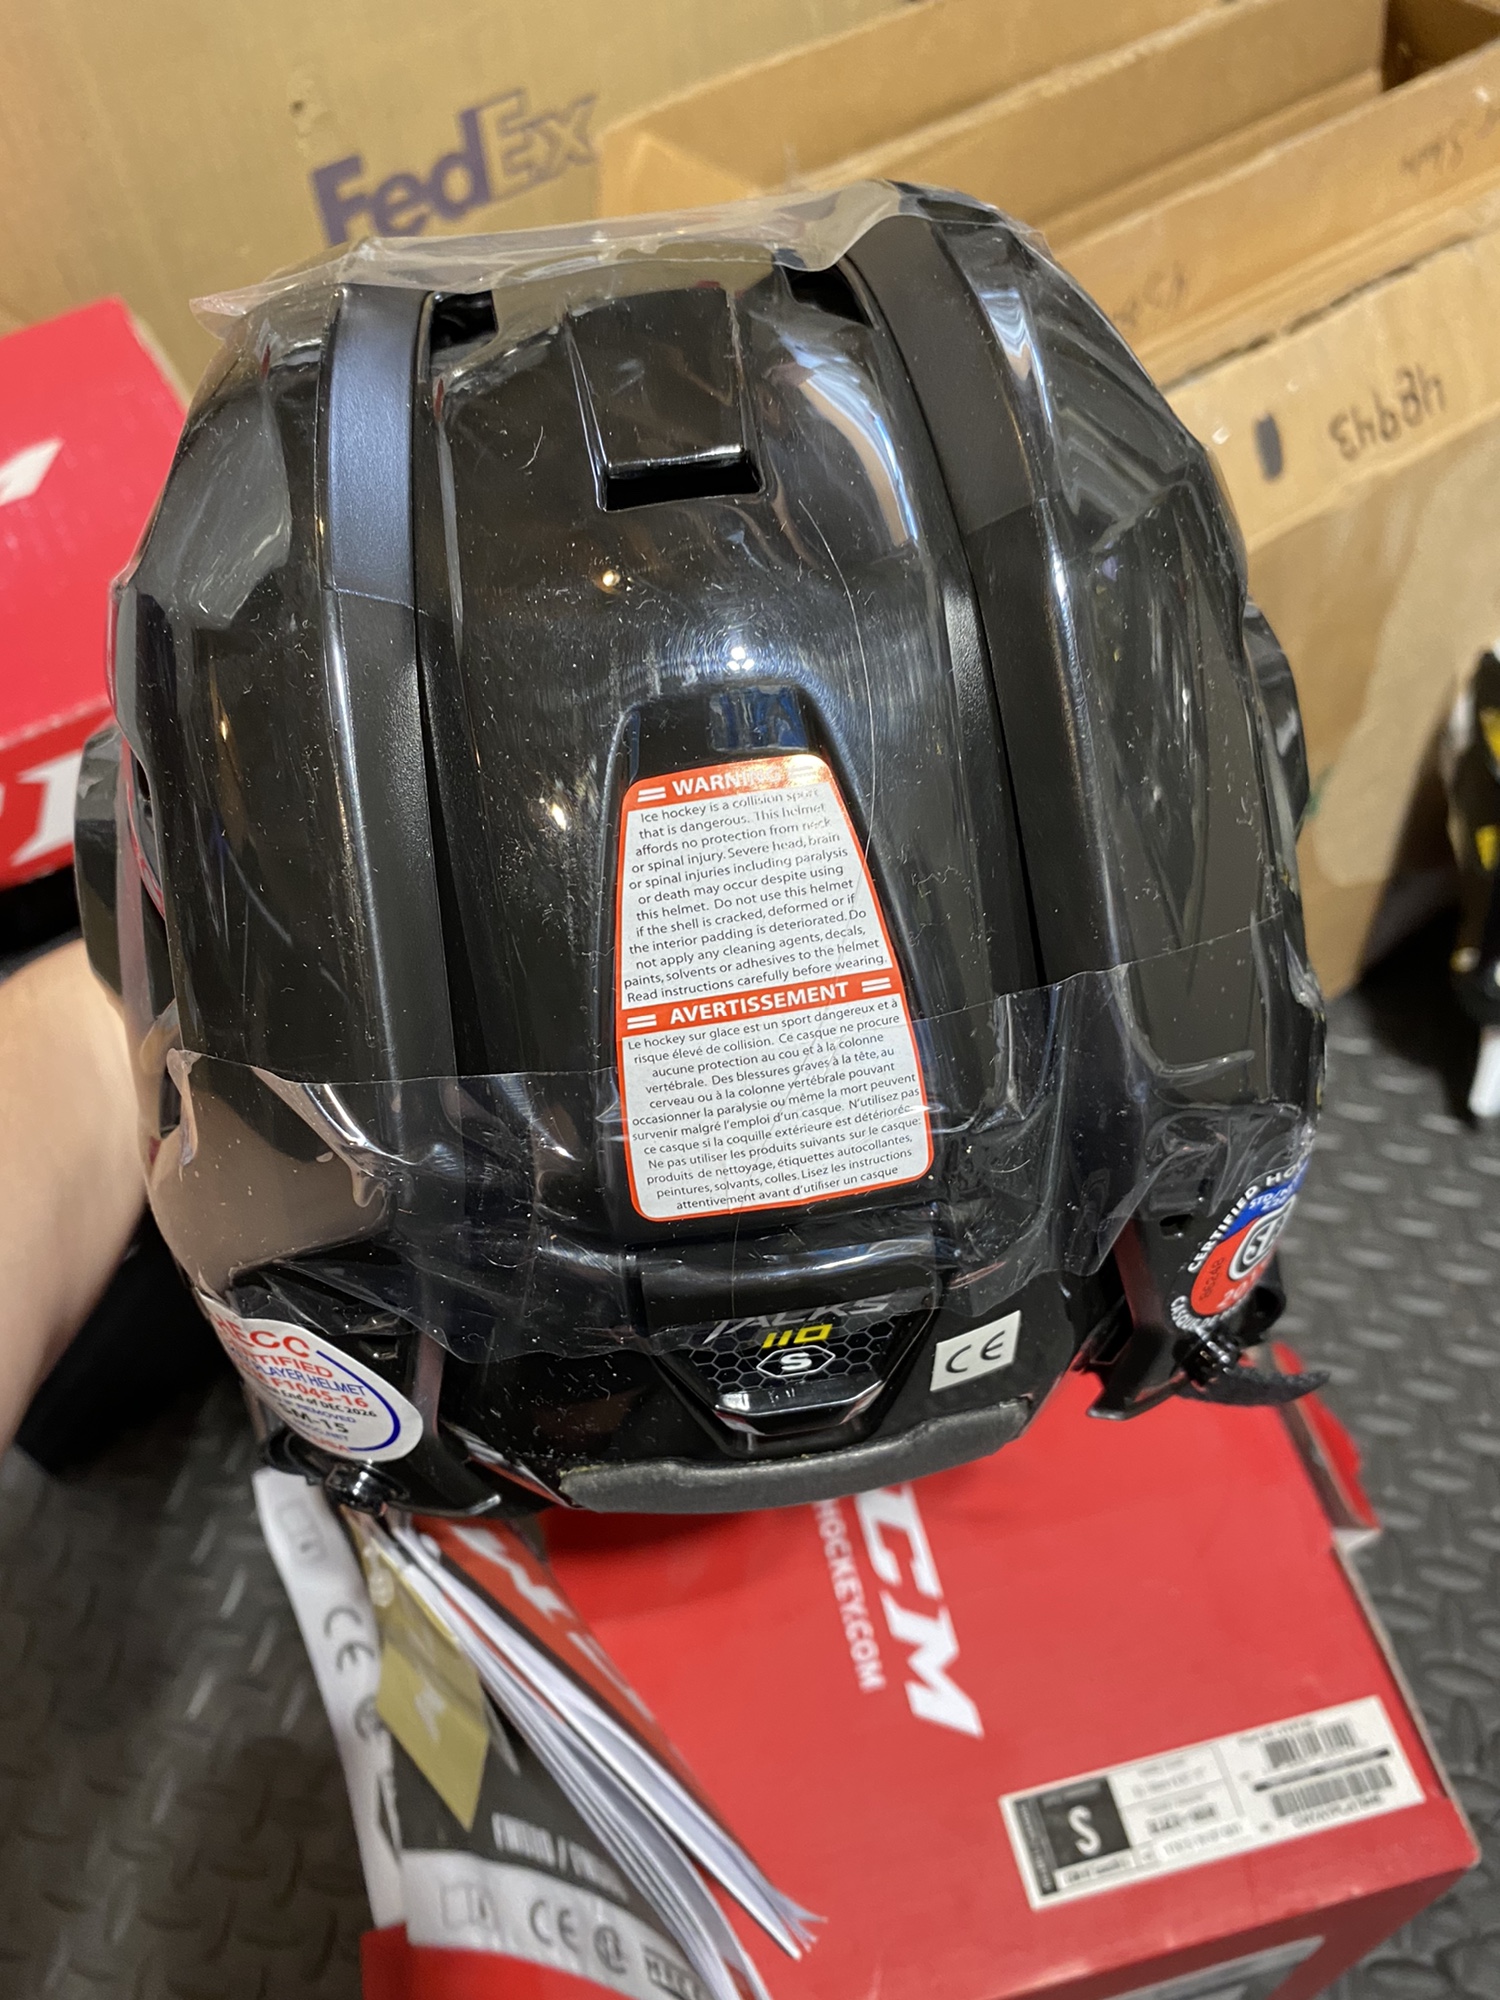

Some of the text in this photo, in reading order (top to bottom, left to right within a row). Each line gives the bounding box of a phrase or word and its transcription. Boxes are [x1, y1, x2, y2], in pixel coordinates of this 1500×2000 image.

[311, 86, 597, 248] FedEx
[672, 766, 782, 797] WARNING
[638, 826, 667, 839] that
[666, 824, 680, 834] is
[679, 816, 751, 832] dangerous.
[754, 809, 780, 821] This
[640, 812, 659, 822] Ice
[660, 805, 708, 819] hockey
[709, 802, 721, 812] is
[721, 802, 730, 810] a
[630, 864, 646, 873] or
[646, 855, 685, 872] spinal
[686, 852, 727, 865] injury.
[727, 845, 770, 858] Severe
[807, 832, 841, 845] brain
[634, 841, 681, 856] affords
[680, 839, 700, 849] no
[699, 829, 767, 848] protection
[767, 824, 800, 835] from
[627, 847, 849, 889] or spinal injuries including paralysis
[637, 865, 844, 904] or death may occur despite using
[635, 879, 854, 921] this helmet. Do not use this helmet
[635, 893, 857, 937] if the shell is cracked, deformed or if
[628, 909, 868, 954] the interior padding is deteriorated. Do
[635, 925, 866, 969] not apply any cleaning agents, decals,
[623, 938, 880, 990] paints, solvents or adhesives to the helmet
[626, 955, 888, 1003] Read instructions carefully before wearing.
[627, 997, 899, 1050] Le hockey sur glace est un sport dangereux et à
[669, 981, 850, 1025] AVERTISSEMENT
[633, 1016, 901, 1065] risque élevé de collision. Ce casque ne procure
[651, 1035, 885, 1078] aucune protection au cou et à la colonne
[648, 1062, 896, 1109] cerveau ou à la colonne vertébrale pouvant
[646, 1138, 913, 1187] produits de nettoyage, étiquettes autocollantes,
[656, 1151, 913, 1202] peintures, solvants, colles. Lisez les instructions
[675, 1190, 757, 1211] attentivement
[757, 1186, 791, 1200] avant
[842, 1176, 858, 1185] un
[859, 1168, 899, 1181] casque
[1187, 1185, 1260, 1273] CERTIFIED
[780, 1351, 813, 1371] S
[945, 1330, 1006, 1374] CE
[308, 1375, 367, 1397] HELMET
[811, 1499, 887, 1694] HOCKEY.COM
[855, 1481, 985, 1740] CM
[1068, 1805, 1101, 1855] S
[529, 1898, 578, 1953] CE
